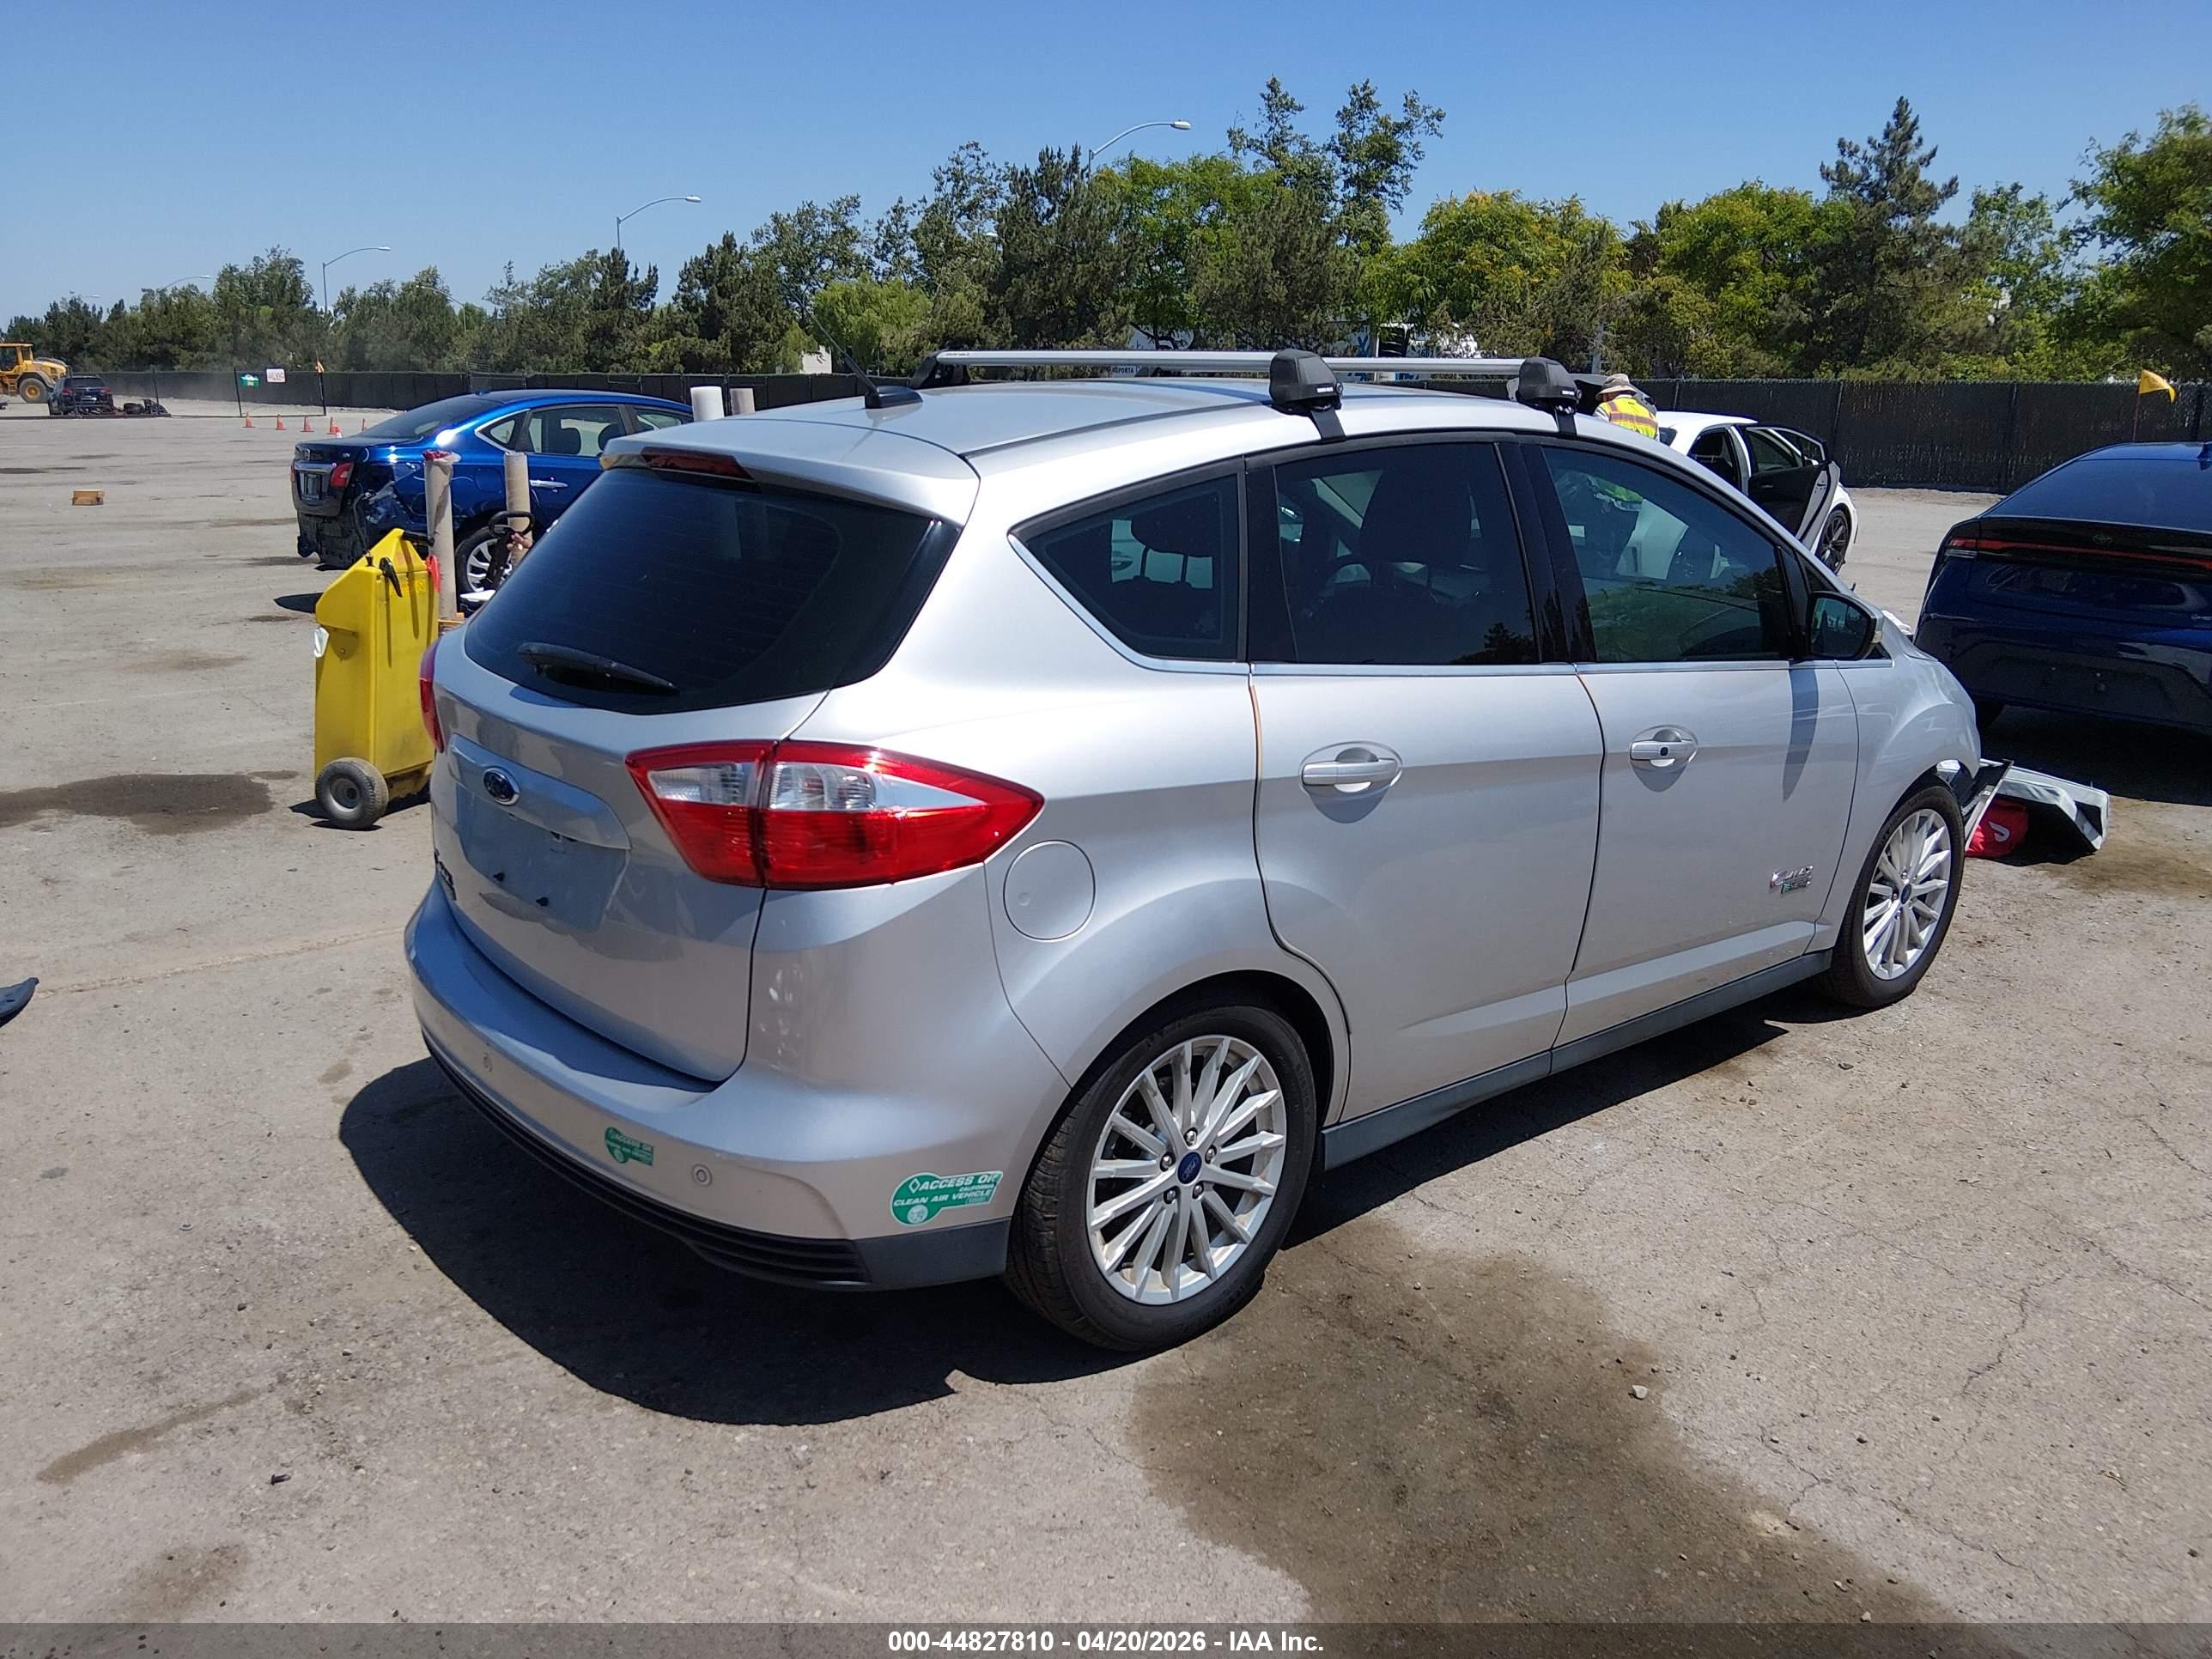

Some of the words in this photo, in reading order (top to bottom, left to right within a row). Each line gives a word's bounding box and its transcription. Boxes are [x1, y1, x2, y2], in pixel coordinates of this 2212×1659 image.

[919, 1176, 975, 1191] ACCESS
[978, 1173, 999, 1183] OK
[894, 1197, 928, 1206] CLEAN
[952, 1189, 992, 1200] VEHICLE
